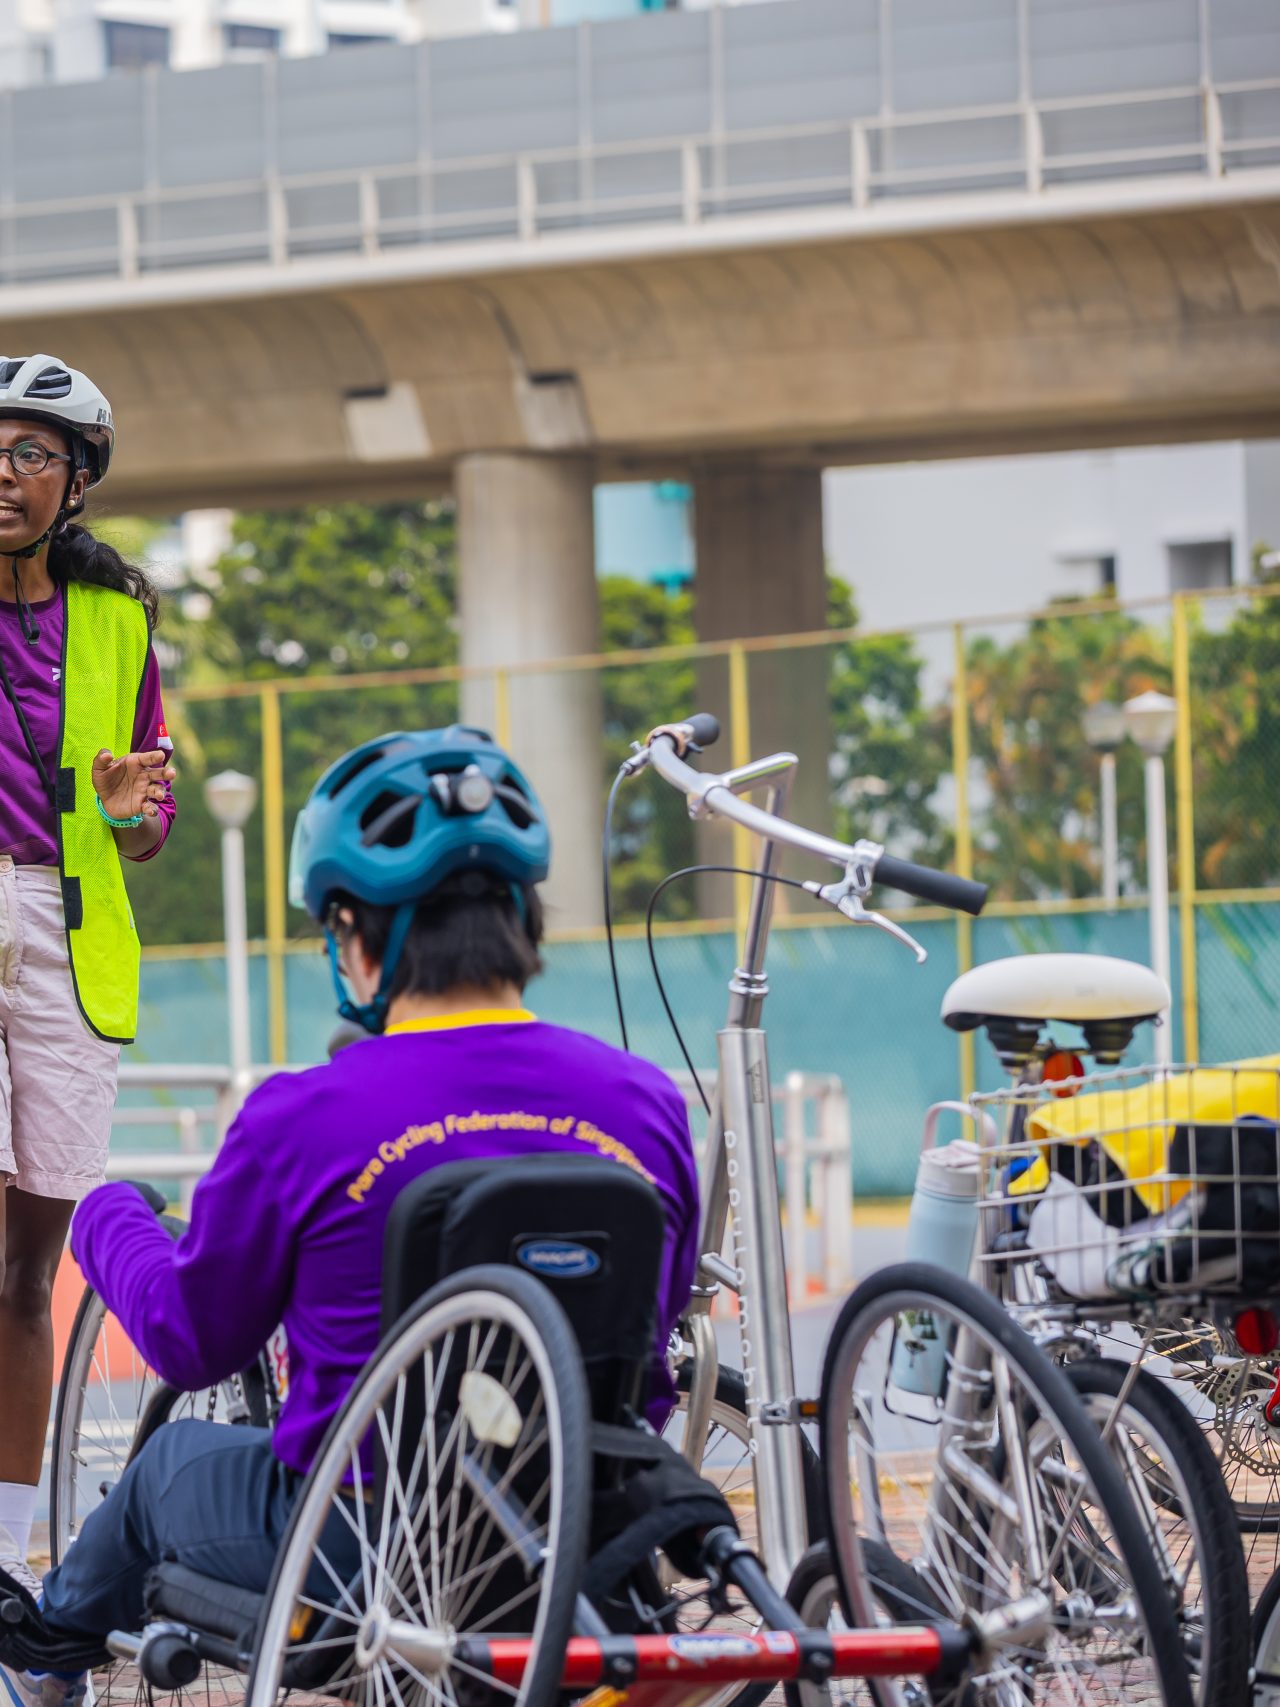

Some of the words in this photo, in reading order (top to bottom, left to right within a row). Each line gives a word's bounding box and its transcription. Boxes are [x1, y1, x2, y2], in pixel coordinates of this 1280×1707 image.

[347, 1158, 385, 1202] Para
[378, 1121, 446, 1163] Cycling
[445, 1111, 548, 1134] Federation
[550, 1116, 575, 1135] of
